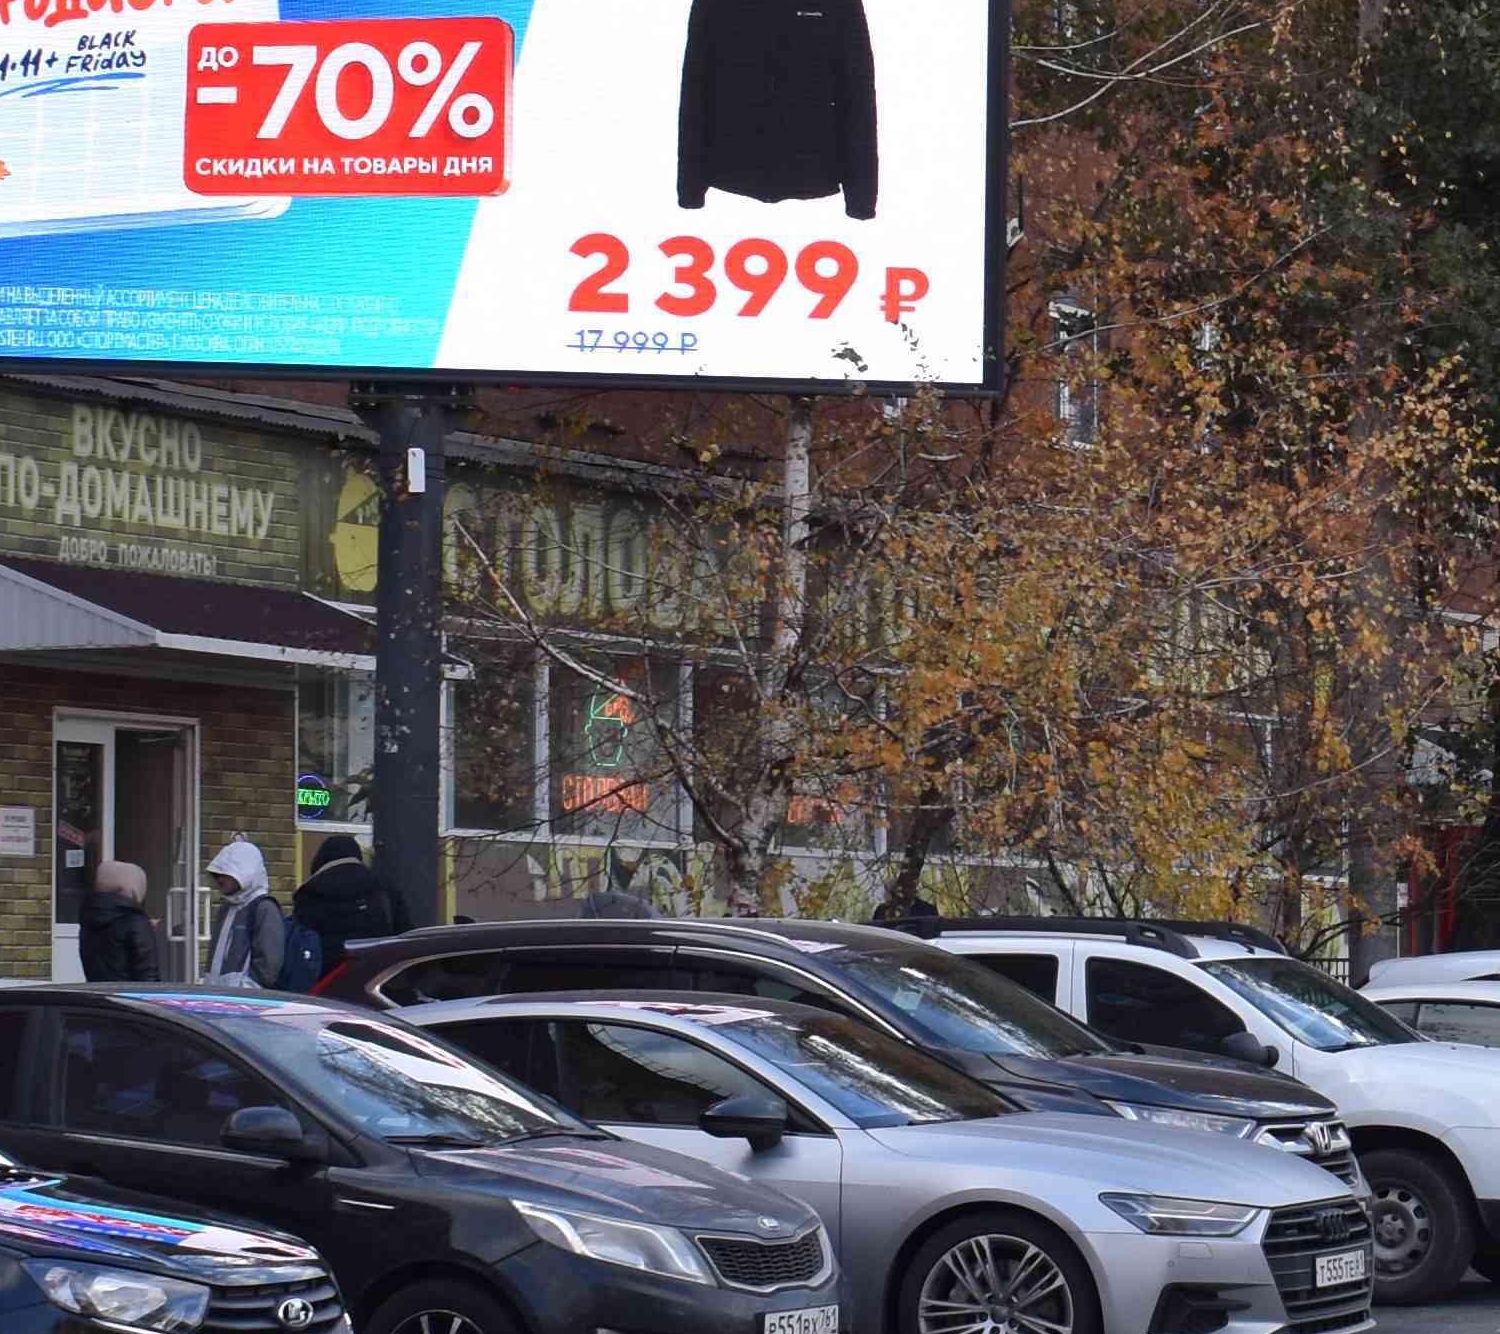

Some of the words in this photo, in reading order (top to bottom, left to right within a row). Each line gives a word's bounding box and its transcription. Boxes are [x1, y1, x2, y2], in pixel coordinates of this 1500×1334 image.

[77, 29, 137, 51] BLACK
[197, 46, 240, 72] ДО
[195, 157, 296, 178] СКИДКИ
[302, 156, 335, 175] НА
[340, 156, 439, 176] ТОВАРЫ
[442, 155, 494, 177] ДНЯ
[71, 402, 202, 473] ВКУСНО
[58, 535, 109, 564] ДОБРО
